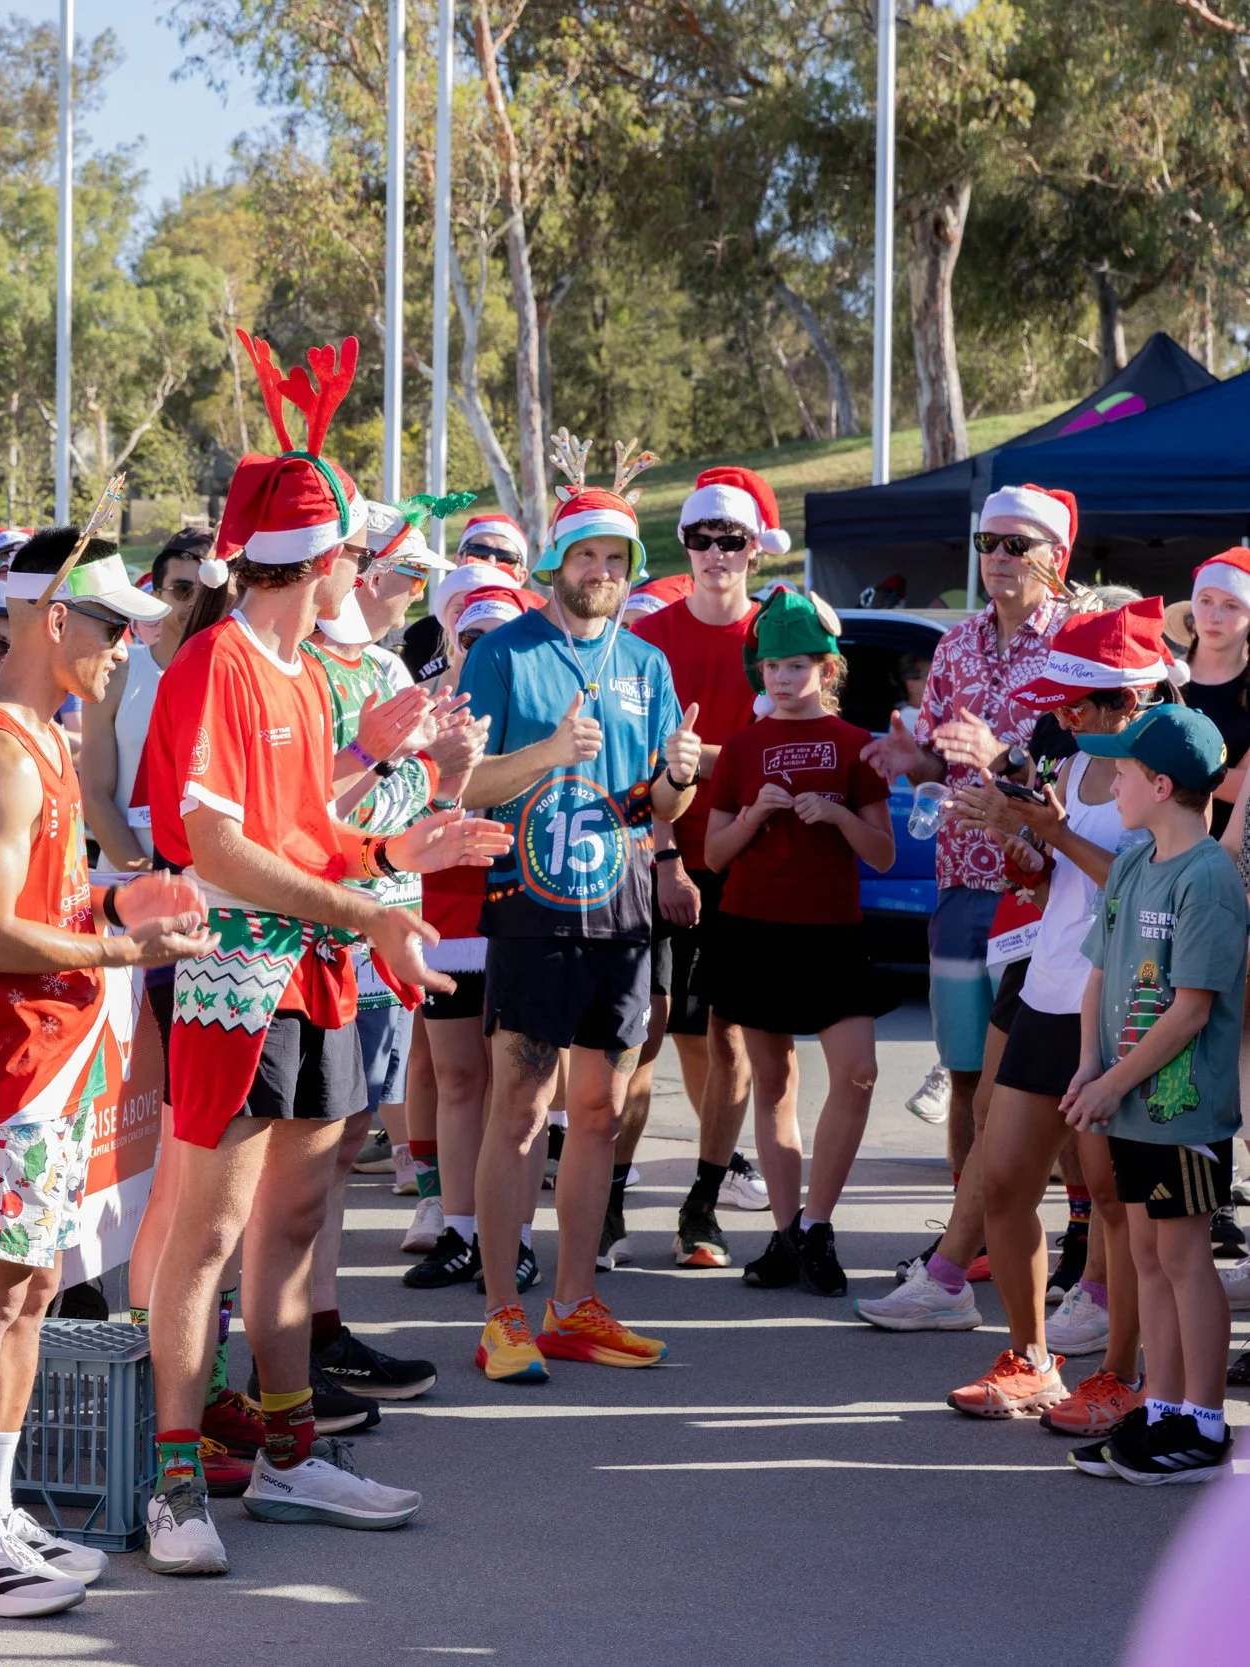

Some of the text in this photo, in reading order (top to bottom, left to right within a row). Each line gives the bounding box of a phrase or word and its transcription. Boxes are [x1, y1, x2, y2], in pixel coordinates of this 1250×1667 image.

[418, 657, 444, 680] JUST
[1048, 656, 1095, 678] Santa Run
[1035, 694, 1065, 704] MEXICO
[570, 786, 596, 802] 2023
[545, 809, 605, 875] 15
[568, 879, 605, 896] YEARS
[122, 1089, 158, 1129] ABOVE
[91, 1144, 110, 1158] CAPITAL
[321, 1366, 371, 1377] ALTRA
[260, 1472, 294, 1493] saucony
